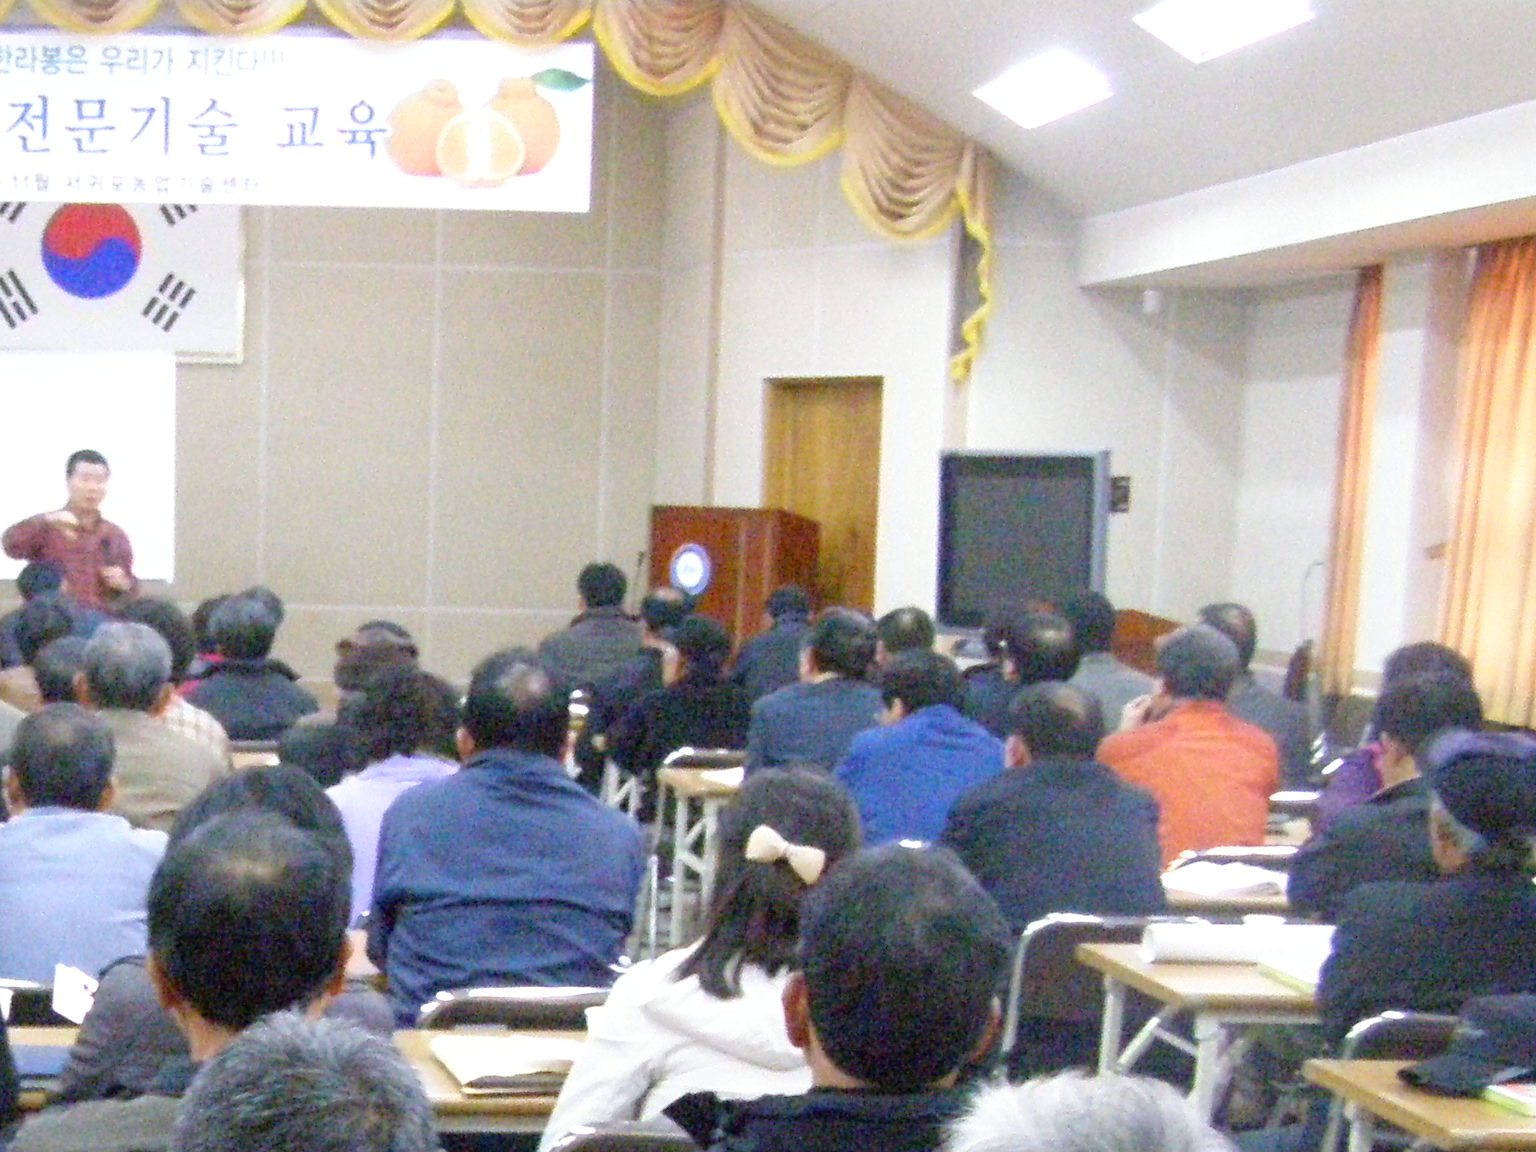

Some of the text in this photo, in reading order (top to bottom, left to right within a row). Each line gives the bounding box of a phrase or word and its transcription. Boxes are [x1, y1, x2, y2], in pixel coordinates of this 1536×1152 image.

[99, 45, 174, 76] 우리가
[6, 95, 237, 156] 전문기술
[276, 100, 387, 160] 교육
